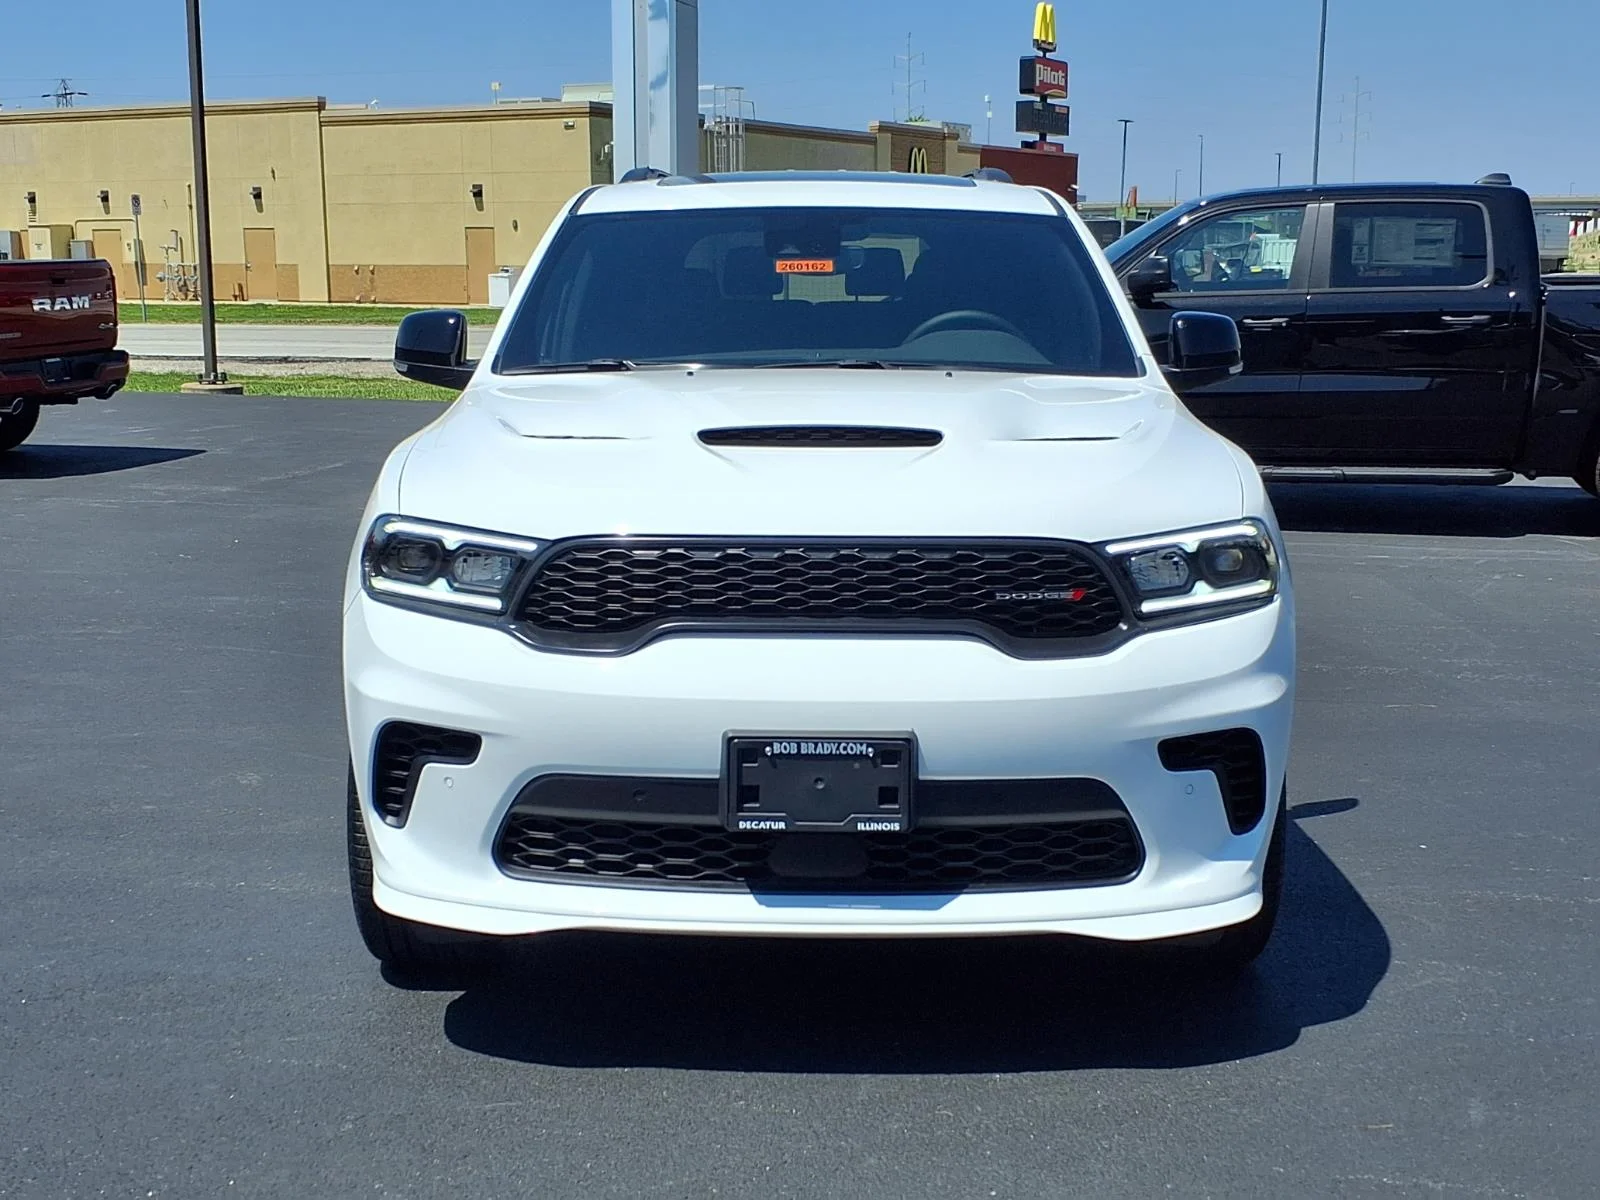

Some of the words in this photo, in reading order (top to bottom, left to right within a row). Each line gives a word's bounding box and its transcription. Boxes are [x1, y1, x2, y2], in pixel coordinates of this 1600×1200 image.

[781, 262, 827, 271] 260162
[32, 296, 90, 312] RAM
[995, 591, 1073, 600] DODGE
[772, 742, 798, 754] BOB
[800, 742, 867, 755] BRADY.COM
[738, 820, 786, 830] DECATUR
[857, 822, 900, 831] ILLINOIS
